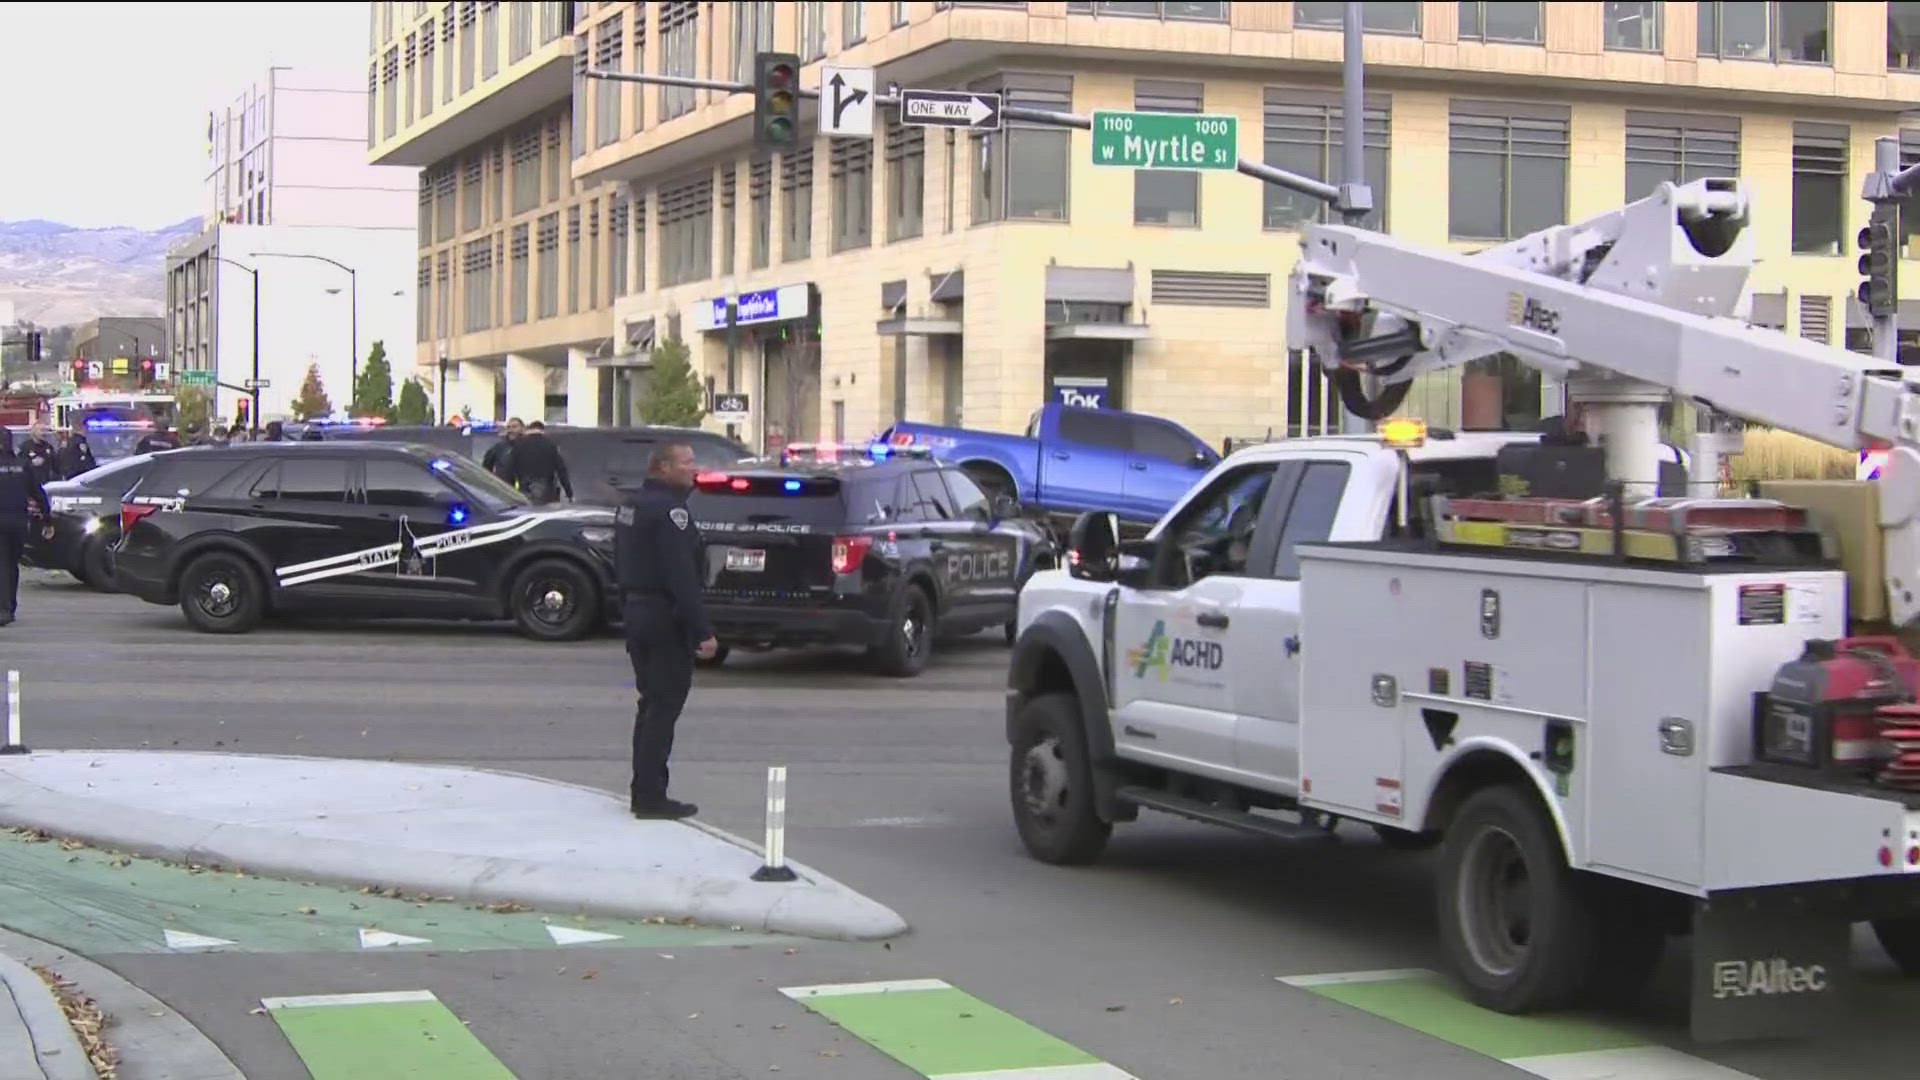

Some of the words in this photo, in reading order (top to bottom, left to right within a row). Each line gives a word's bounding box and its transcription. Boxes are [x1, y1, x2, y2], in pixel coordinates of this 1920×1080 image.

[911, 102, 939, 115] ONE
[943, 103, 970, 116] WAY
[1103, 117, 1133, 132] 1100
[1195, 120, 1228, 135] 1000
[1101, 148, 1115, 160] W
[1124, 134, 1206, 167] Myrtle
[1214, 148, 1228, 163] St
[757, 522, 811, 534] POLICE
[359, 549, 398, 566] STATE
[434, 531, 472, 550] POLICE
[947, 550, 1010, 581] POLICE
[1171, 638, 1224, 670] ACHD
[1750, 959, 1826, 995] Altec
